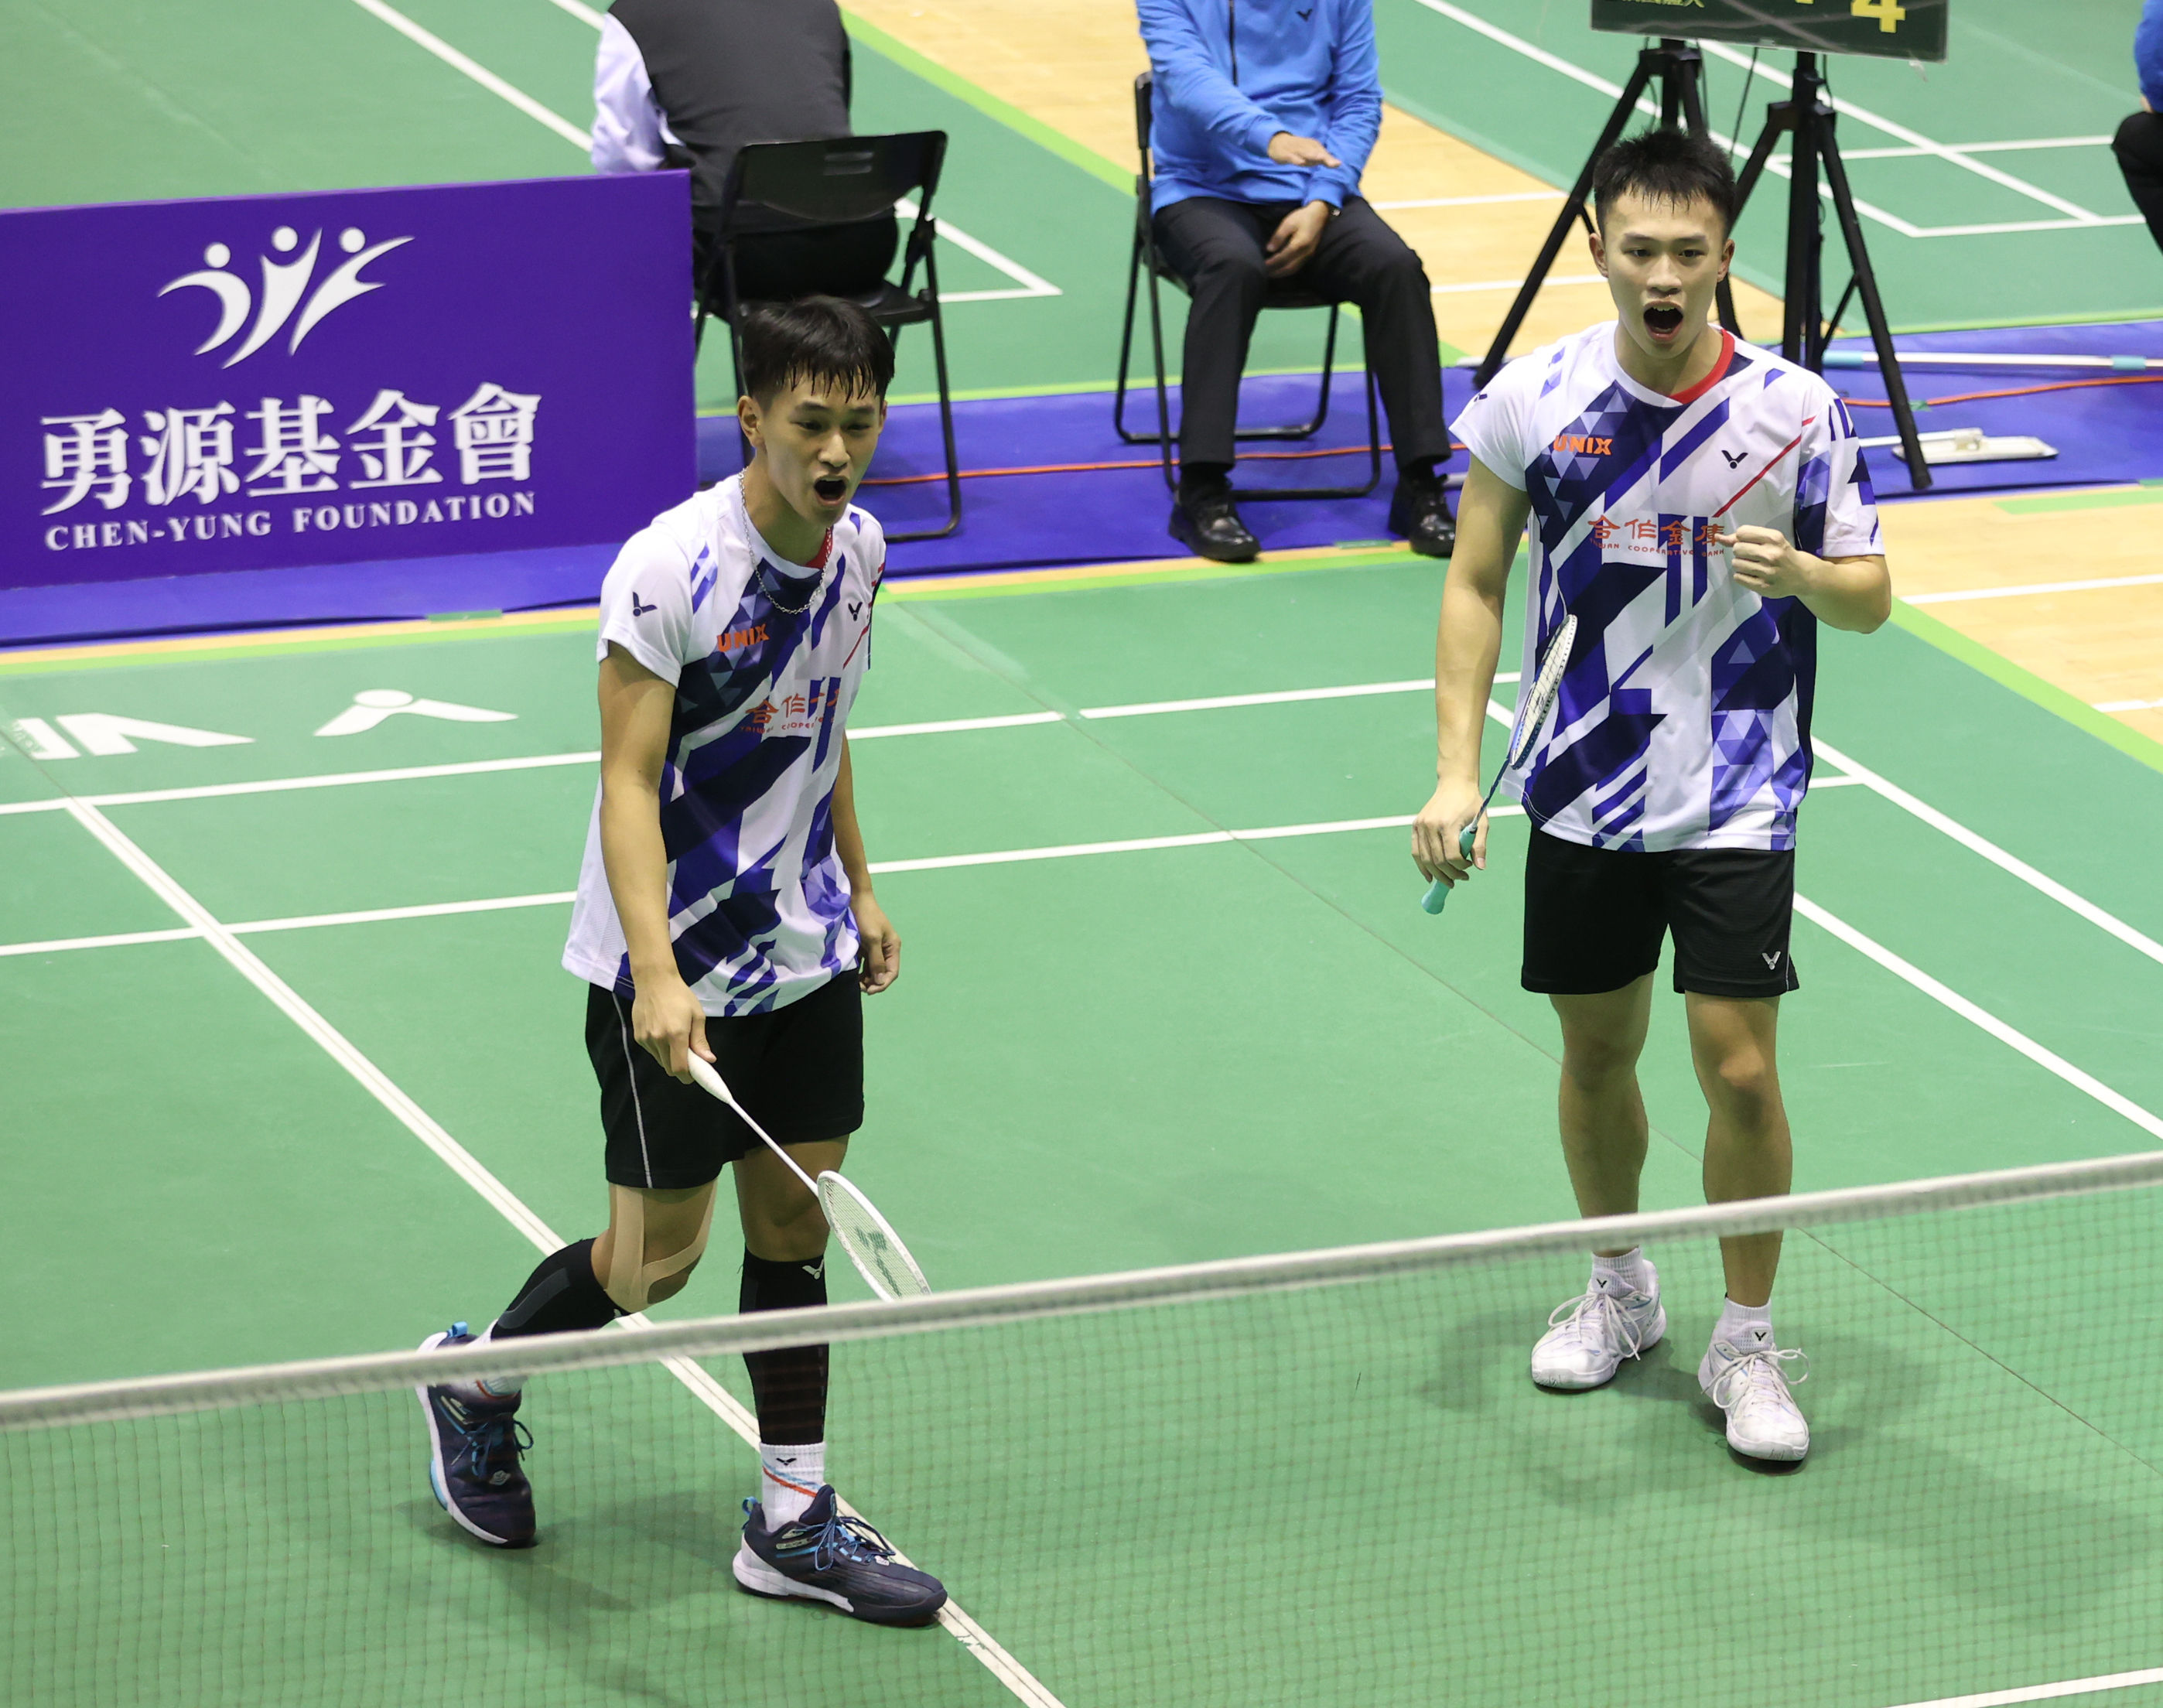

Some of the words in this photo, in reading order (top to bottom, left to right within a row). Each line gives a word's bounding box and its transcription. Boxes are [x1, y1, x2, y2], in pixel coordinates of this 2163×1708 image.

[40, 382, 542, 515] 勇源基金會
[1553, 435, 1613, 456] UNIX
[45, 511, 272, 551] CHEN-YUNG
[293, 492, 535, 533] FOUNDATION
[716, 623, 771, 652] UNIX
